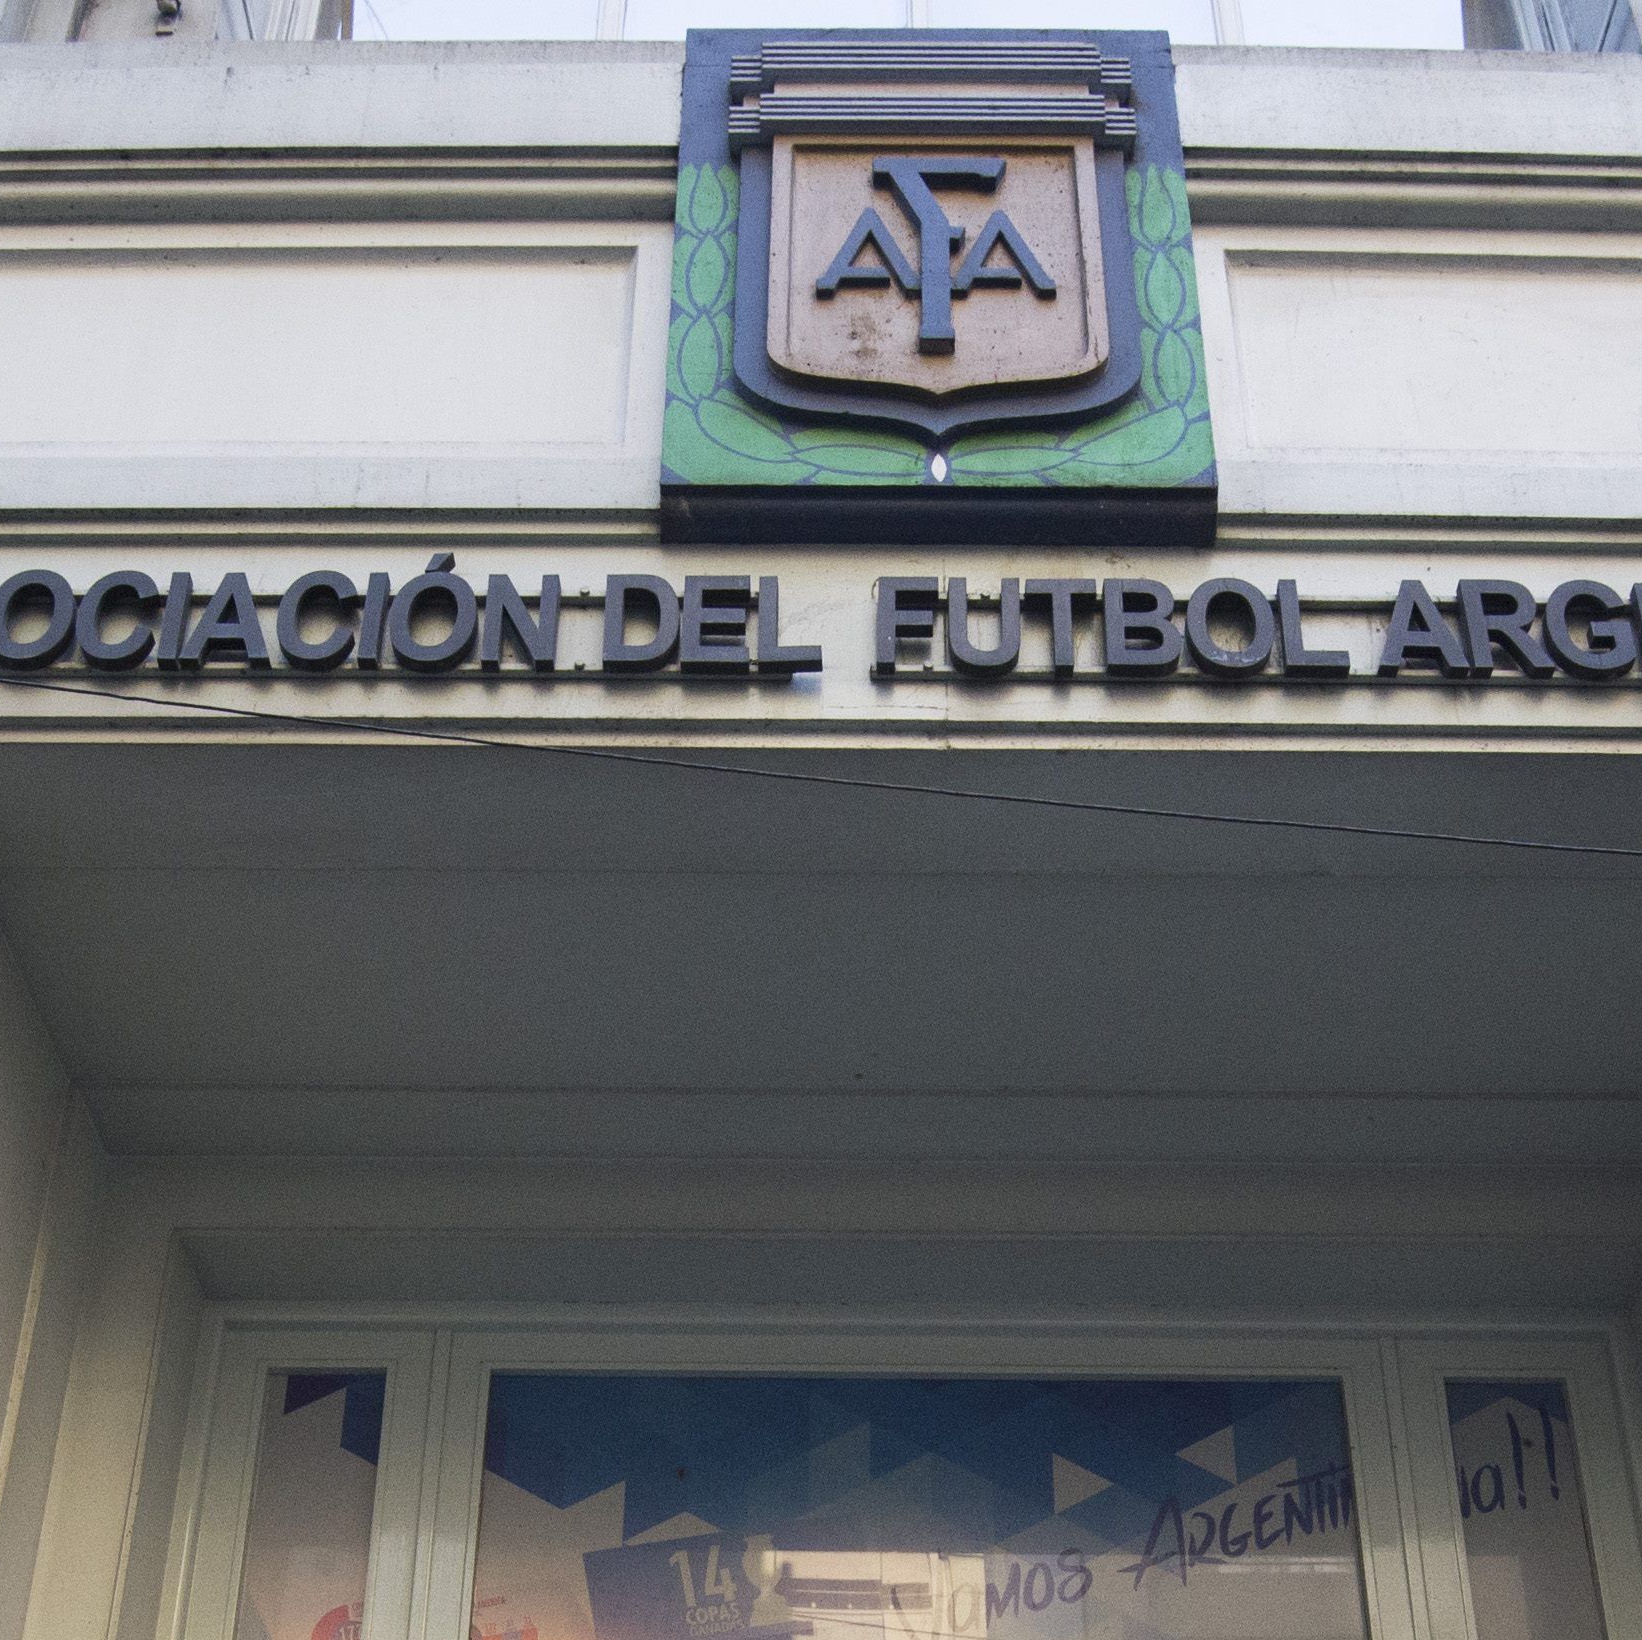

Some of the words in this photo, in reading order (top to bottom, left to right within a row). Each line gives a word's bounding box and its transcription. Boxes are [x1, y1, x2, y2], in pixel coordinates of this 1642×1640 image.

[602, 572, 824, 675] DEL
[873, 575, 1350, 681] FUTBOL
[669, 1545, 736, 1606] 14
[685, 1603, 740, 1625] COPAS
